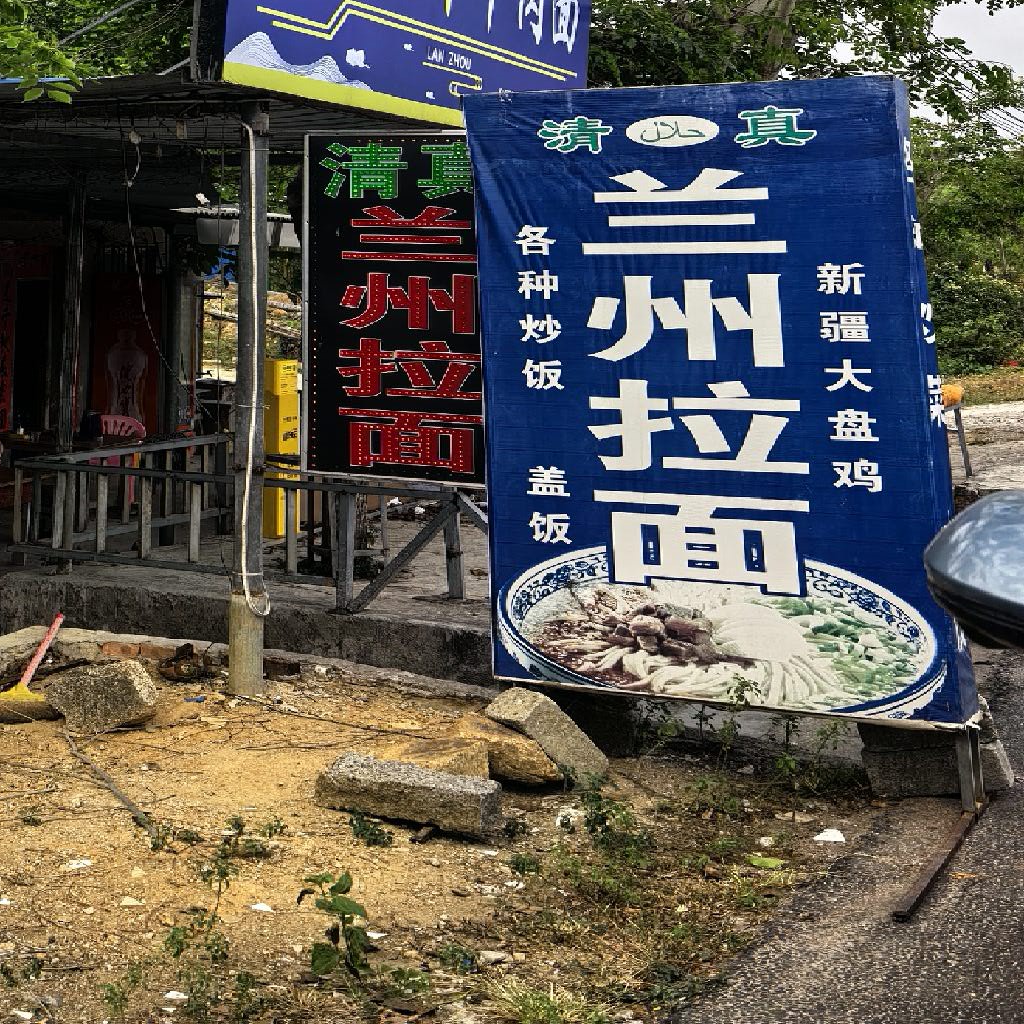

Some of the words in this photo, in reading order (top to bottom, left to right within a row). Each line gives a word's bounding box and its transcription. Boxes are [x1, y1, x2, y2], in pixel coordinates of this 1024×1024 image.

[427, 46, 445, 63] LAN
[448, 51, 472, 70] ZHOU
[319, 142, 474, 200] 清真
[537, 115, 613, 154] 清
[733, 105, 817, 149] 真
[337, 205, 484, 474] 兰州拉面
[514, 225, 565, 391] 各种炒饭
[582, 167, 811, 596] 兰州拉面
[816, 262, 883, 494] 新疆大盘鸡
[527, 465, 573, 545] 盖饭
